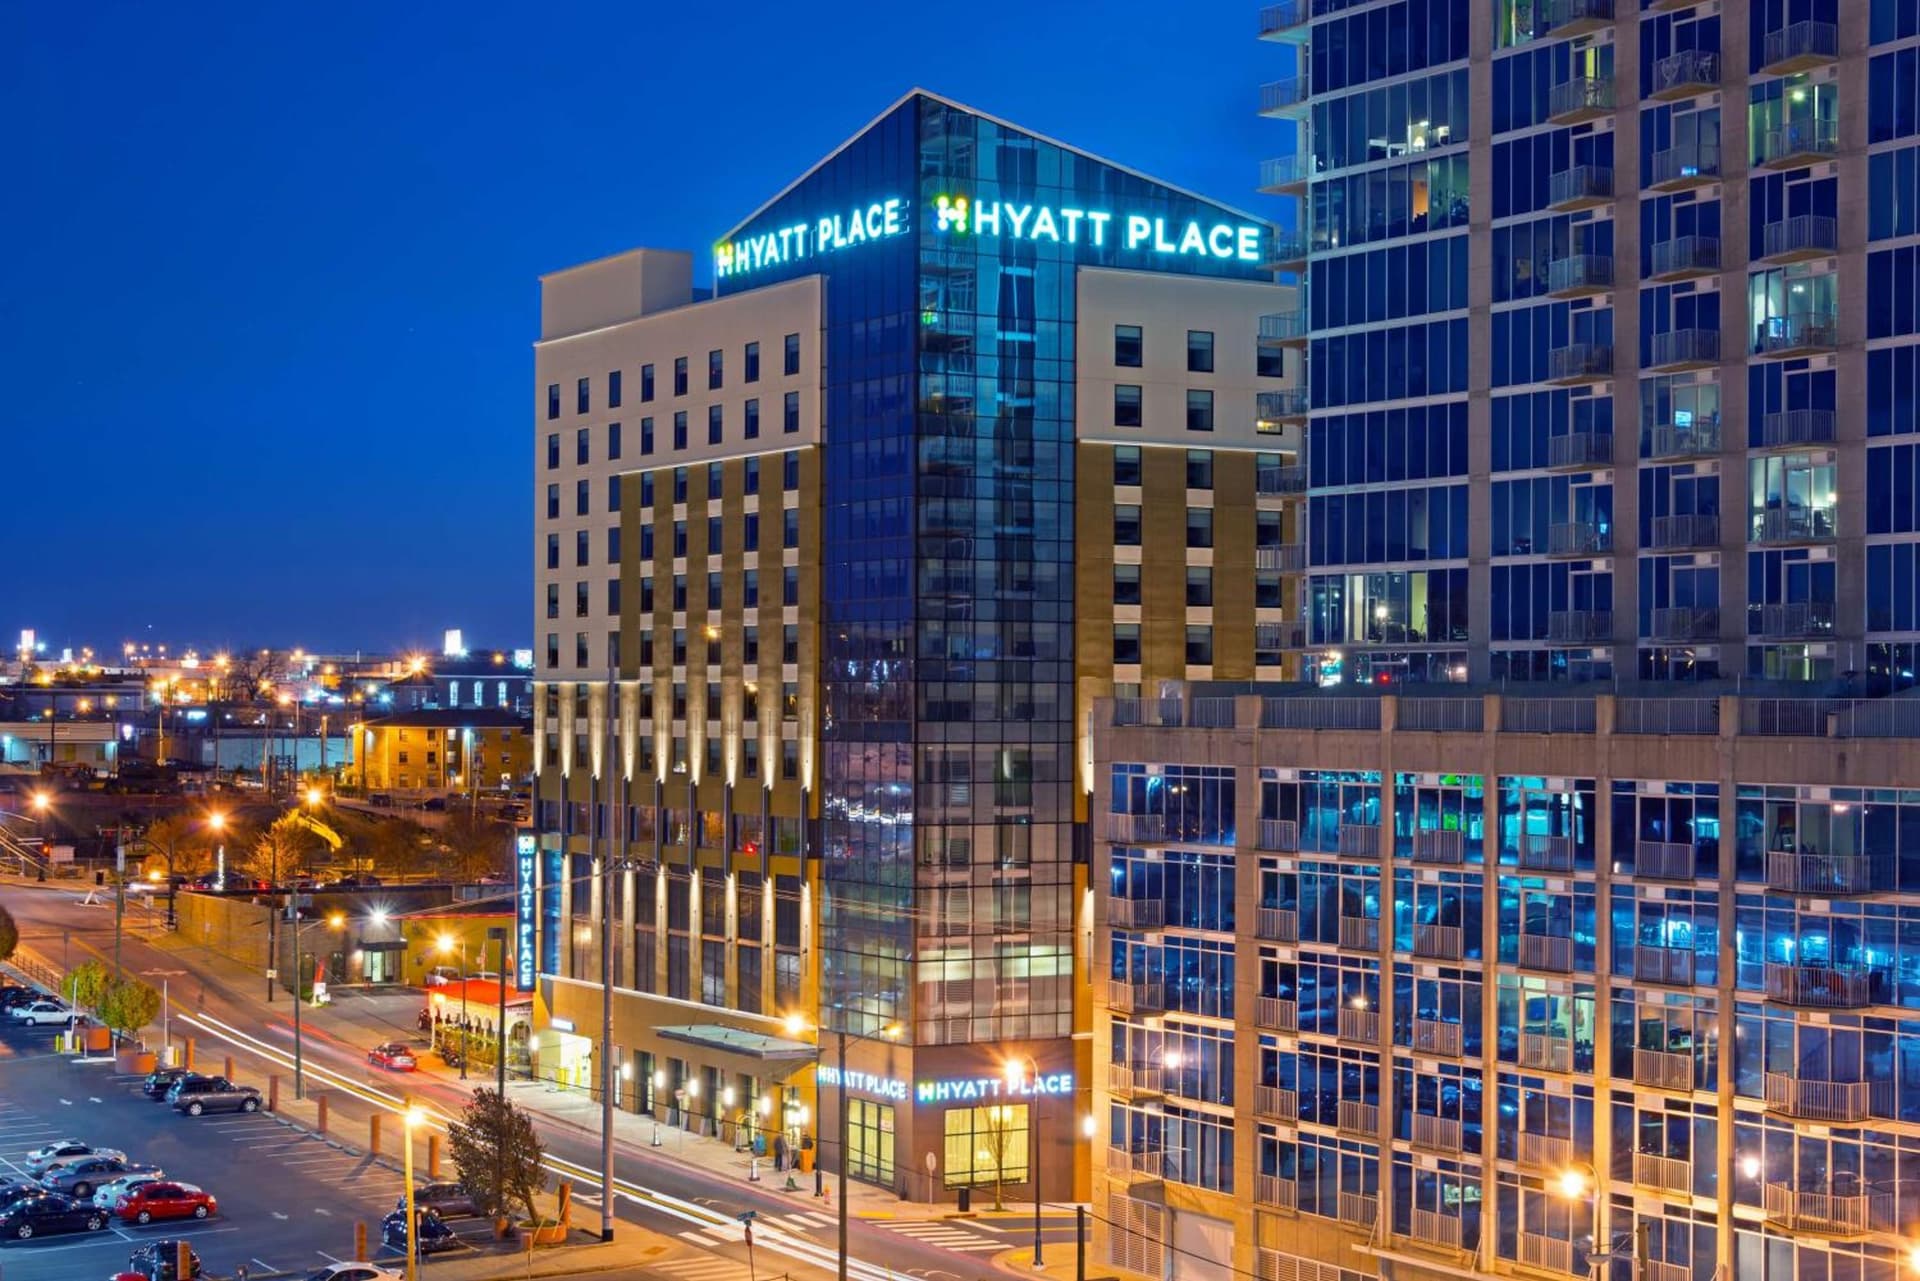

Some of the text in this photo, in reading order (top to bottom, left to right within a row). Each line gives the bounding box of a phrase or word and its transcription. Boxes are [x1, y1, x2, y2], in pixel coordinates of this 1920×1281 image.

[734, 197, 901, 274] HYATT PLACE
[974, 199, 1261, 261] HYATT PLACE
[521, 857, 533, 986] HYATT PLACE
[866, 1074, 907, 1100] PLACE
[935, 1074, 1073, 1100] HYATT PLACE
